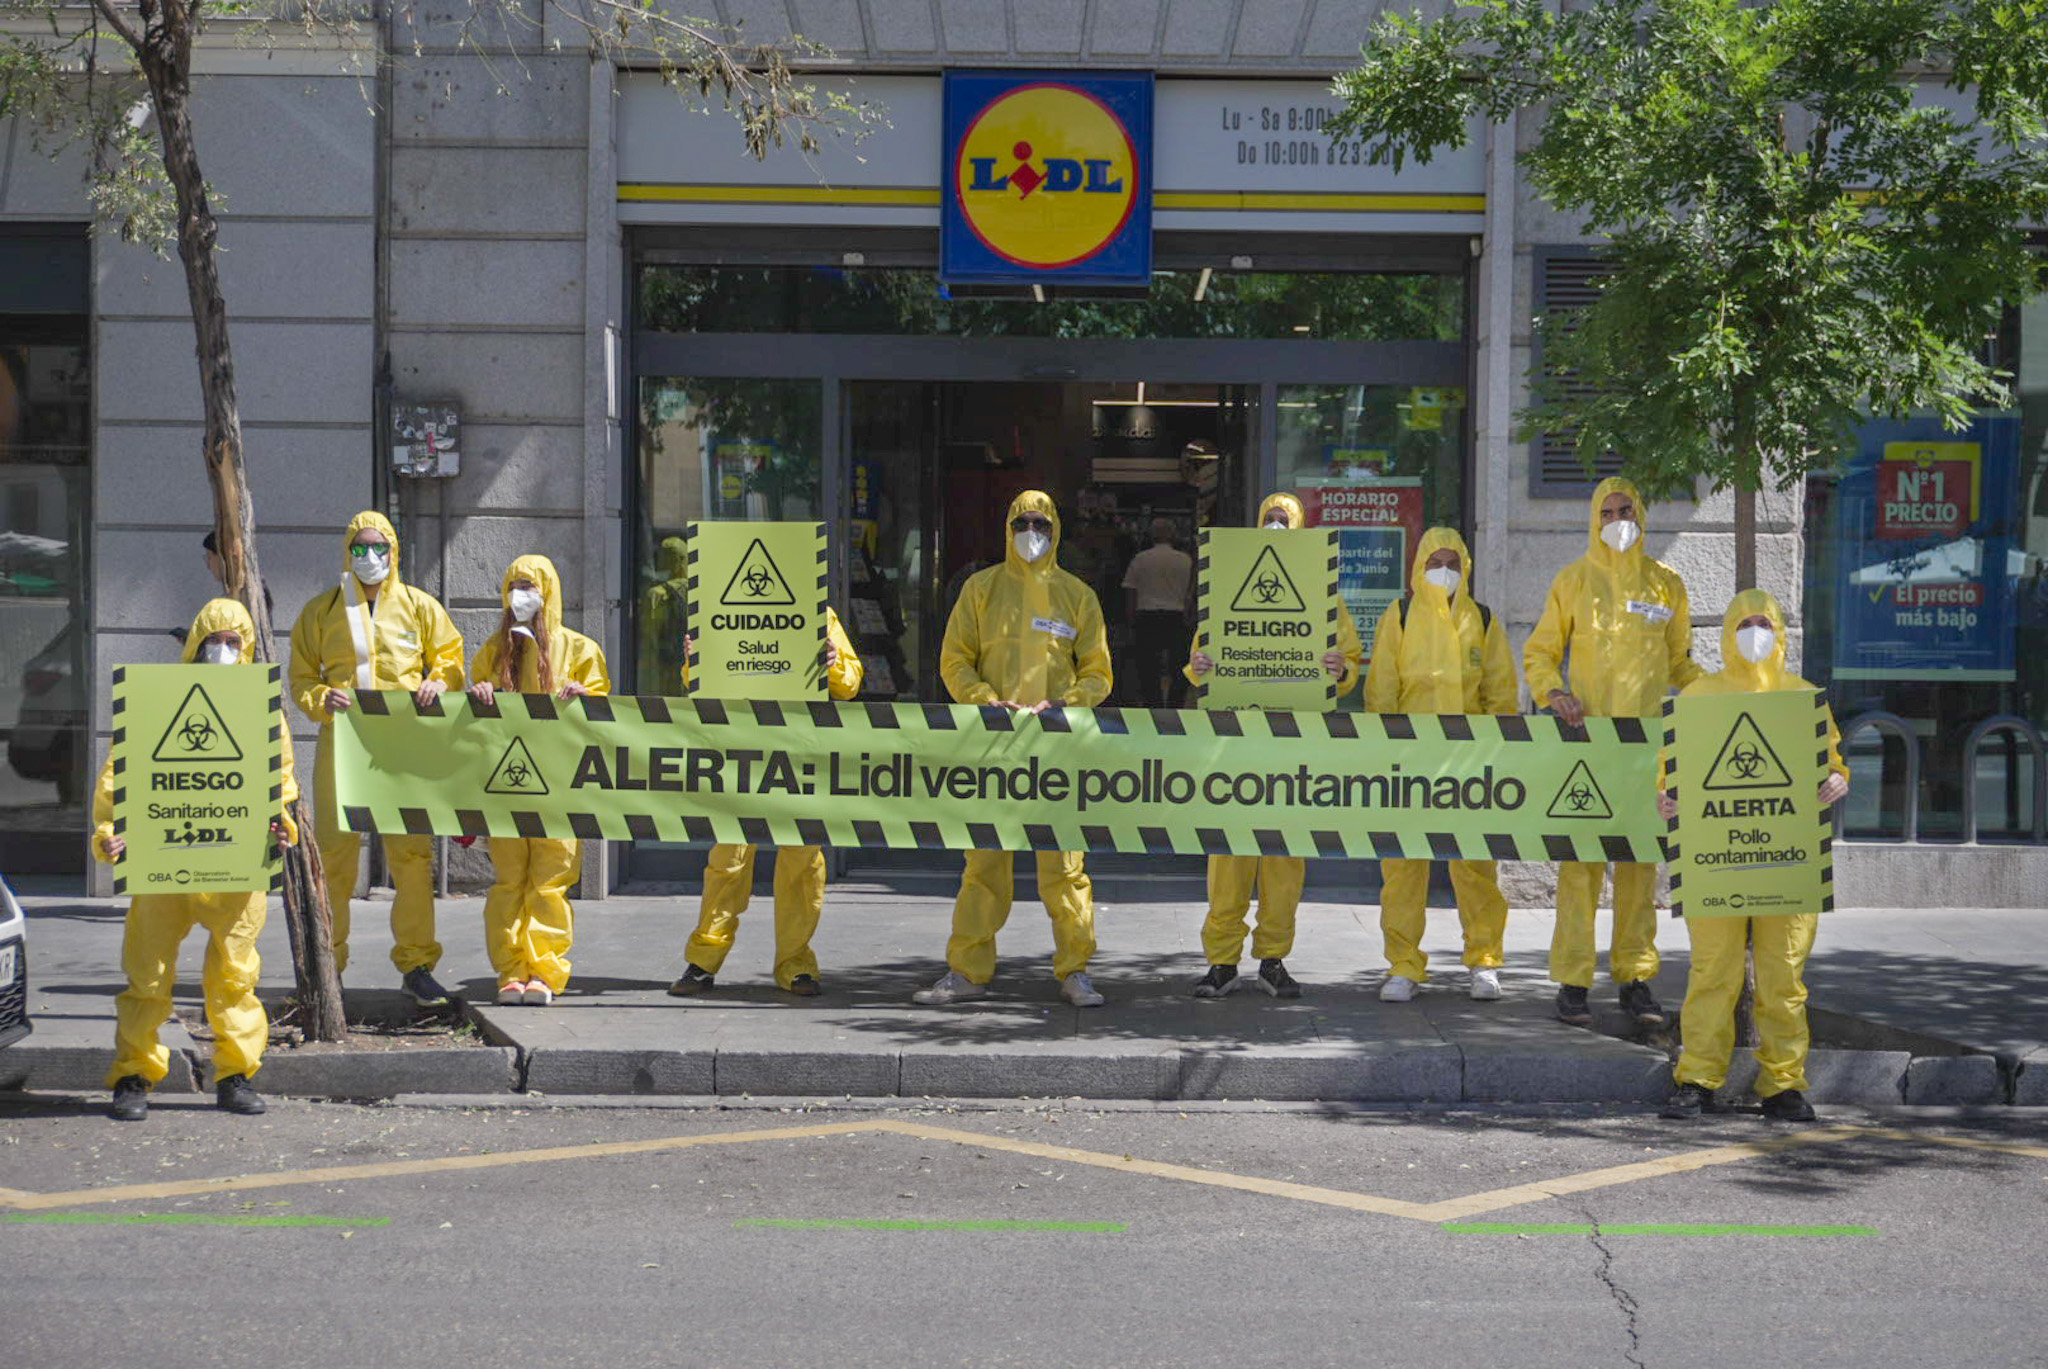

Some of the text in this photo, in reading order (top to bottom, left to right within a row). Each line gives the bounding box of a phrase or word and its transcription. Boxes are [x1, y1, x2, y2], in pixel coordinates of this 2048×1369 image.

[1222, 107, 1241, 130] Lu
[1261, 107, 1280, 130] Sa
[1237, 141, 1256, 164] Do
[1264, 141, 1318, 165] 10:00h
[969, 141, 1123, 200] LIDL
[1321, 492, 1399, 506] HORARIO
[1322, 508, 1399, 522] ESPECIAL
[1885, 503, 1958, 523] PRECIO
[1373, 547, 1393, 559] del
[1355, 561, 1390, 574] Junio
[1896, 584, 1976, 606] El precio
[711, 614, 805, 630] CUIDADO
[1896, 608, 1978, 631] más bajo
[1223, 621, 1312, 637] PELIGRO
[738, 640, 778, 654] Salud
[1221, 646, 1313, 661] Resistencia a
[726, 657, 791, 673] en riesgo
[1215, 663, 1320, 678] los antibióticos
[151, 772, 244, 791] RIESGO
[570, 745, 1527, 812] ALERTA: Lidl vende pollo contaminado
[148, 803, 248, 819] Sanitario en
[1701, 797, 1796, 818] ALERTA
[163, 821, 233, 847] LIDL
[1728, 828, 1771, 844] Pollo
[1694, 846, 1807, 865] contaminado
[147, 872, 173, 882] OBA
[1702, 897, 1727, 907] OBA
